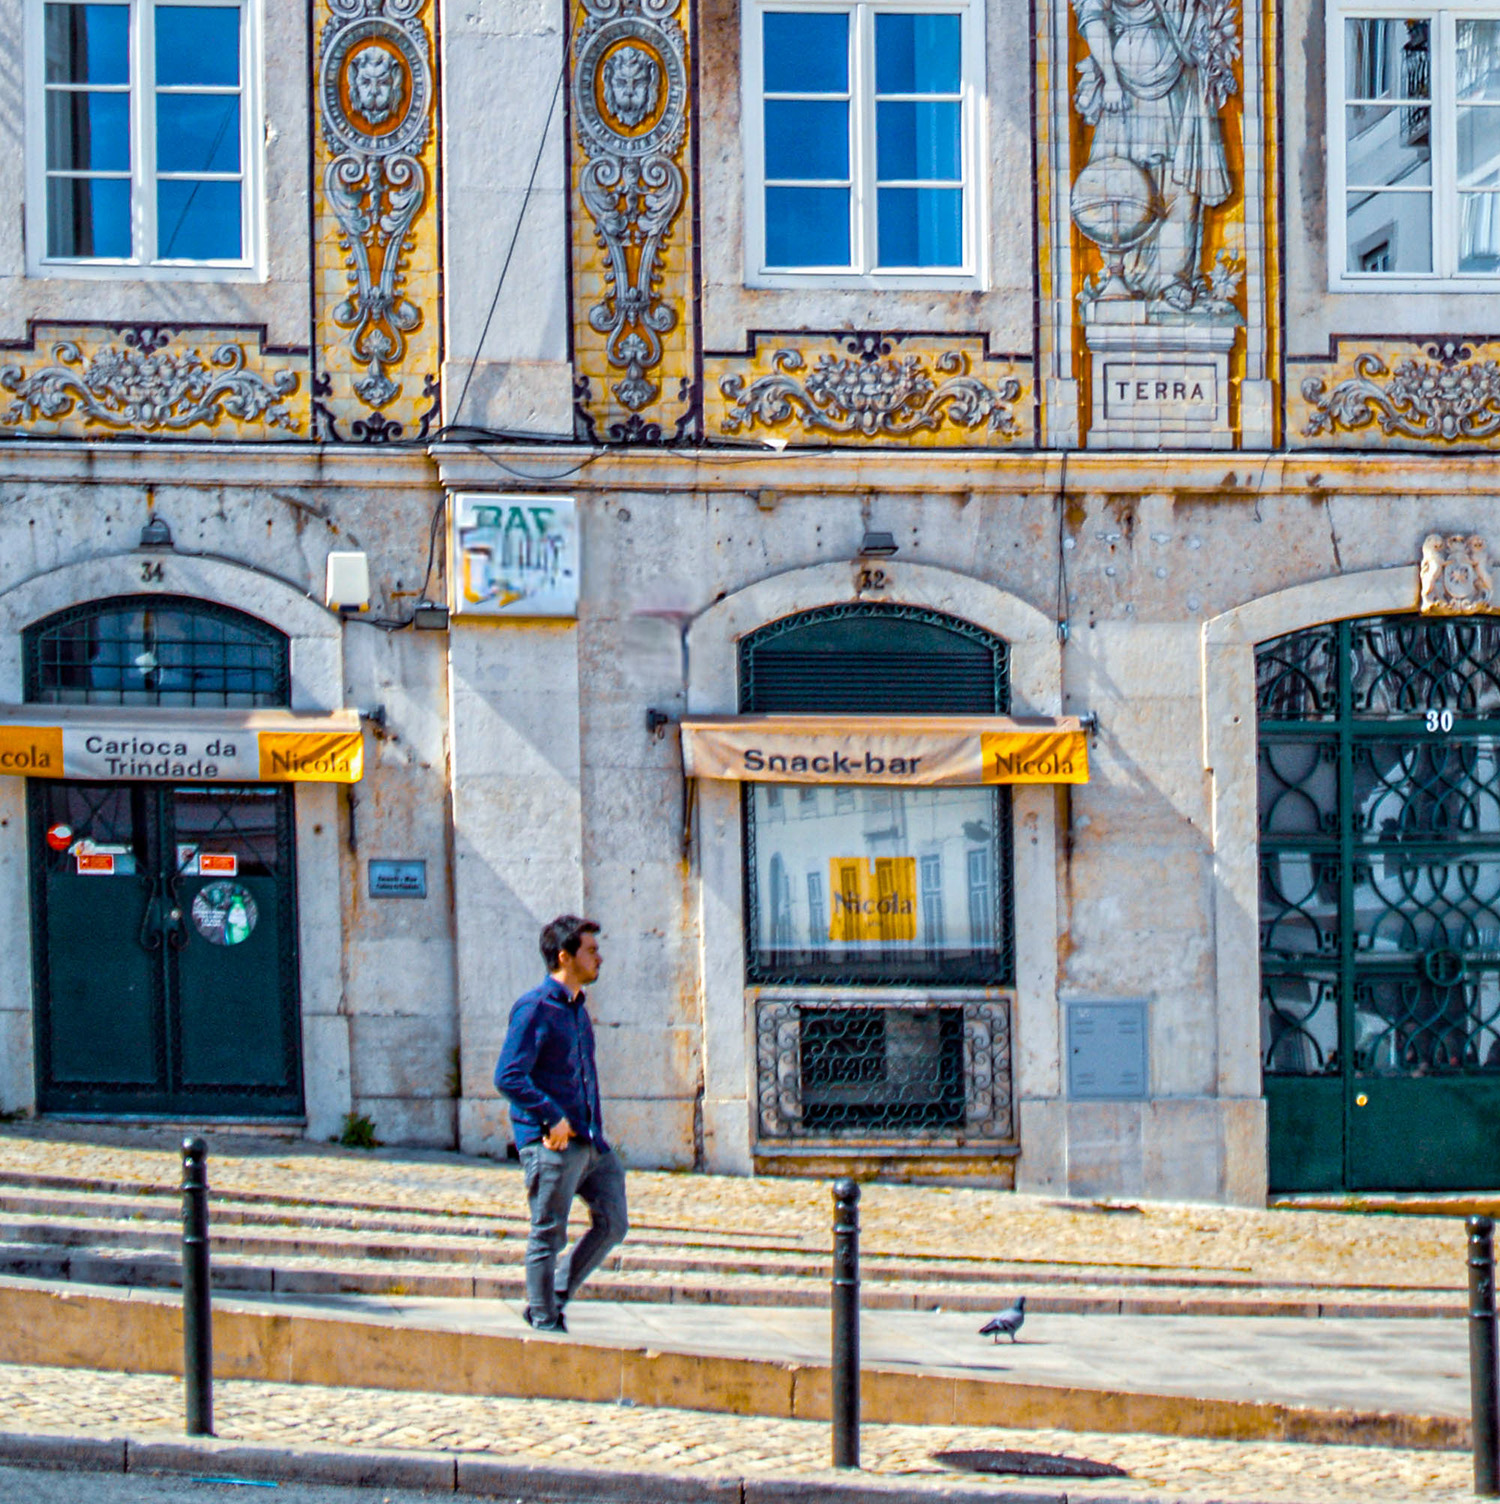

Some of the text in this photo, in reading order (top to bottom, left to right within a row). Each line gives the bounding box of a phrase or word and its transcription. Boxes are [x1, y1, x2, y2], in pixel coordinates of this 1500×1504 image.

[1115, 381, 1204, 401] TERRA
[141, 561, 165, 583] 34
[1426, 708, 1453, 733] 30
[85, 736, 237, 757] Carioca da
[104, 756, 219, 778] Trindade
[271, 749, 350, 775] Nicola
[743, 749, 922, 774] Snack-bar
[995, 752, 1074, 776] Nicola
[834, 891, 912, 914] Nicola
